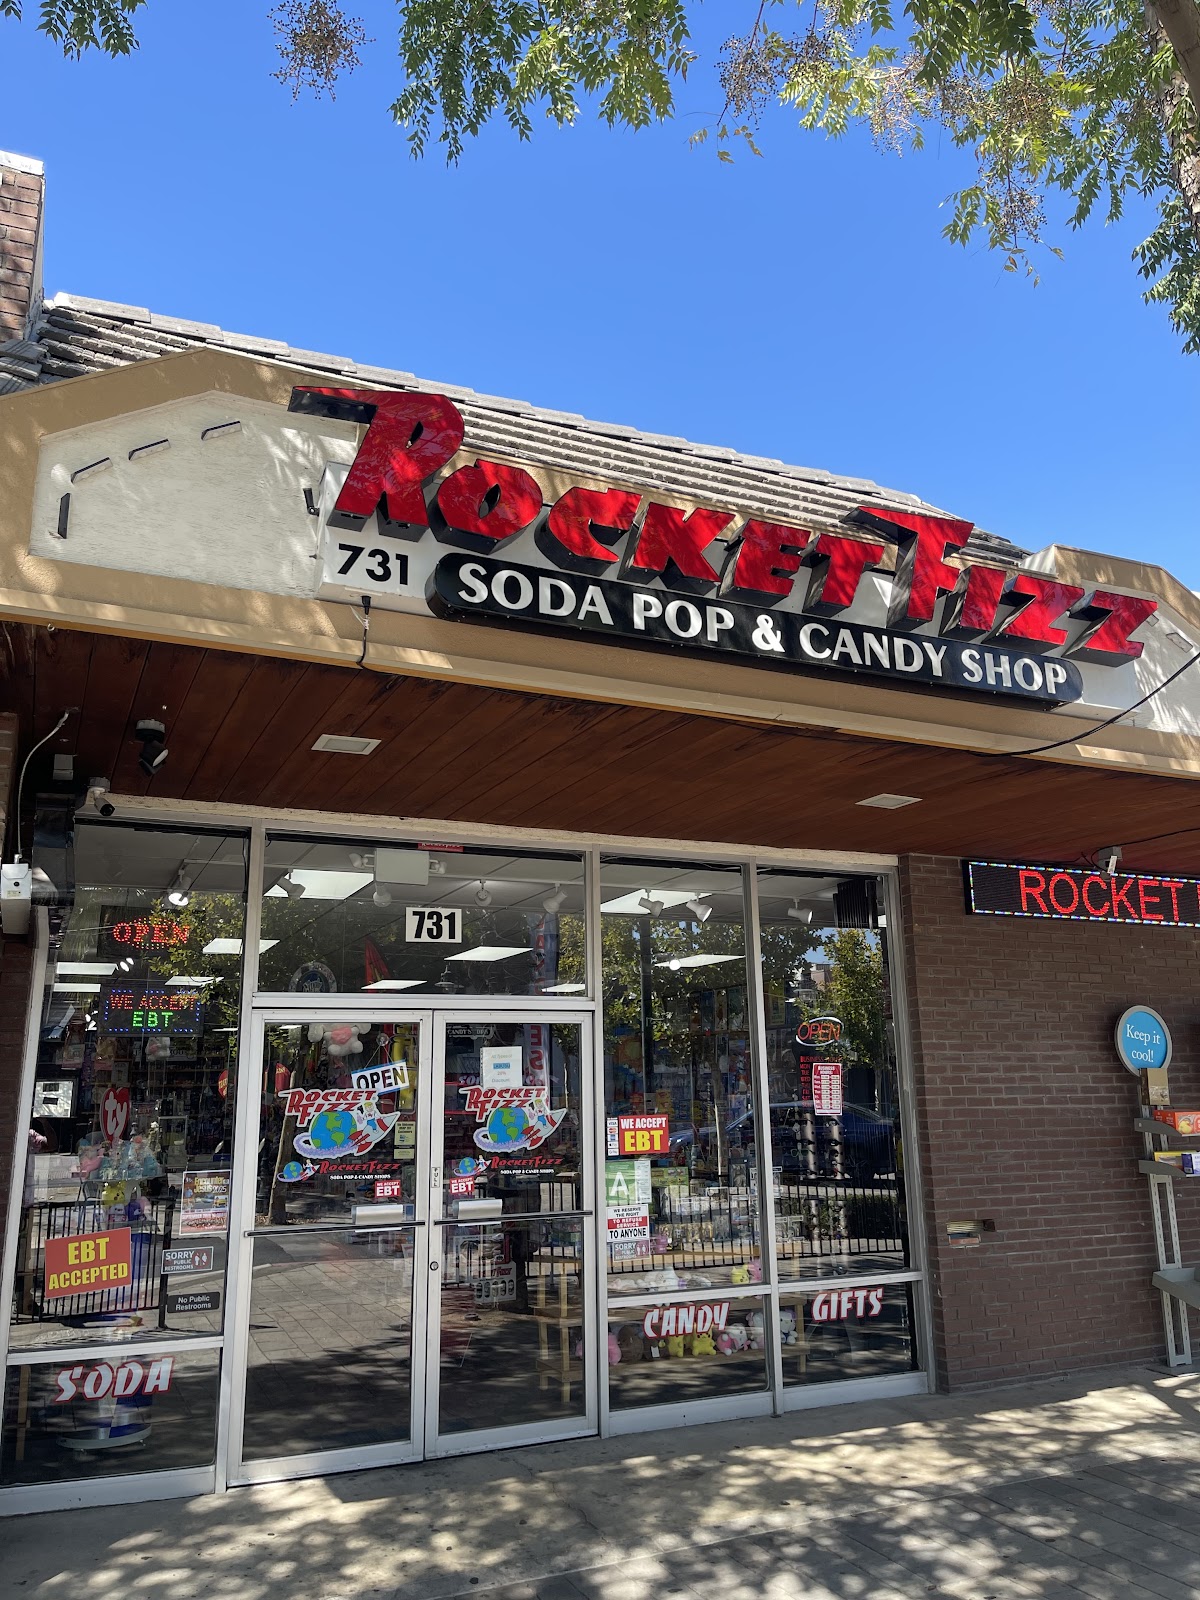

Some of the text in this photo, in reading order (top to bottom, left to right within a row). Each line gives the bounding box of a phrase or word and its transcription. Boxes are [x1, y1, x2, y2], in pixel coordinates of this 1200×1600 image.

[290, 386, 1159, 657] ROCKET FIZZ
[336, 543, 409, 586] 731
[457, 562, 1068, 695] SODA POP & CANDY SHOP
[1018, 869, 1184, 921] ROCKET
[112, 921, 190, 944] OPEN
[411, 910, 456, 940] 731
[110, 995, 198, 1010] WE ACCEPT
[132, 1012, 174, 1028] EBT
[797, 1023, 841, 1041] OPEN
[1125, 1024, 1161, 1046] Keep it
[1131, 1049, 1154, 1063] cool!
[356, 1063, 408, 1089] OPEN
[287, 1089, 377, 1113] ROCKET
[467, 1087, 546, 1109] ROCKET
[477, 1099, 532, 1120] FIZZ
[299, 1102, 360, 1125] FIZZ
[620, 1117, 667, 1129] WE ACCEPT
[624, 1129, 664, 1152] EBT
[376, 1185, 400, 1197] EBT
[451, 1182, 474, 1194] EBT
[609, 1171, 630, 1197] A
[609, 1227, 647, 1239] TO ANYONE
[67, 1237, 110, 1266] EBT
[165, 1250, 195, 1260] SORRY
[614, 1242, 637, 1250] SORRY
[48, 1261, 129, 1290] ACCEPTED
[175, 1302, 211, 1311] Restrooms
[178, 1295, 210, 1304] No Public
[811, 1287, 885, 1322] GIFTS
[642, 1301, 731, 1338] CANDY
[55, 1355, 176, 1404] SODA
